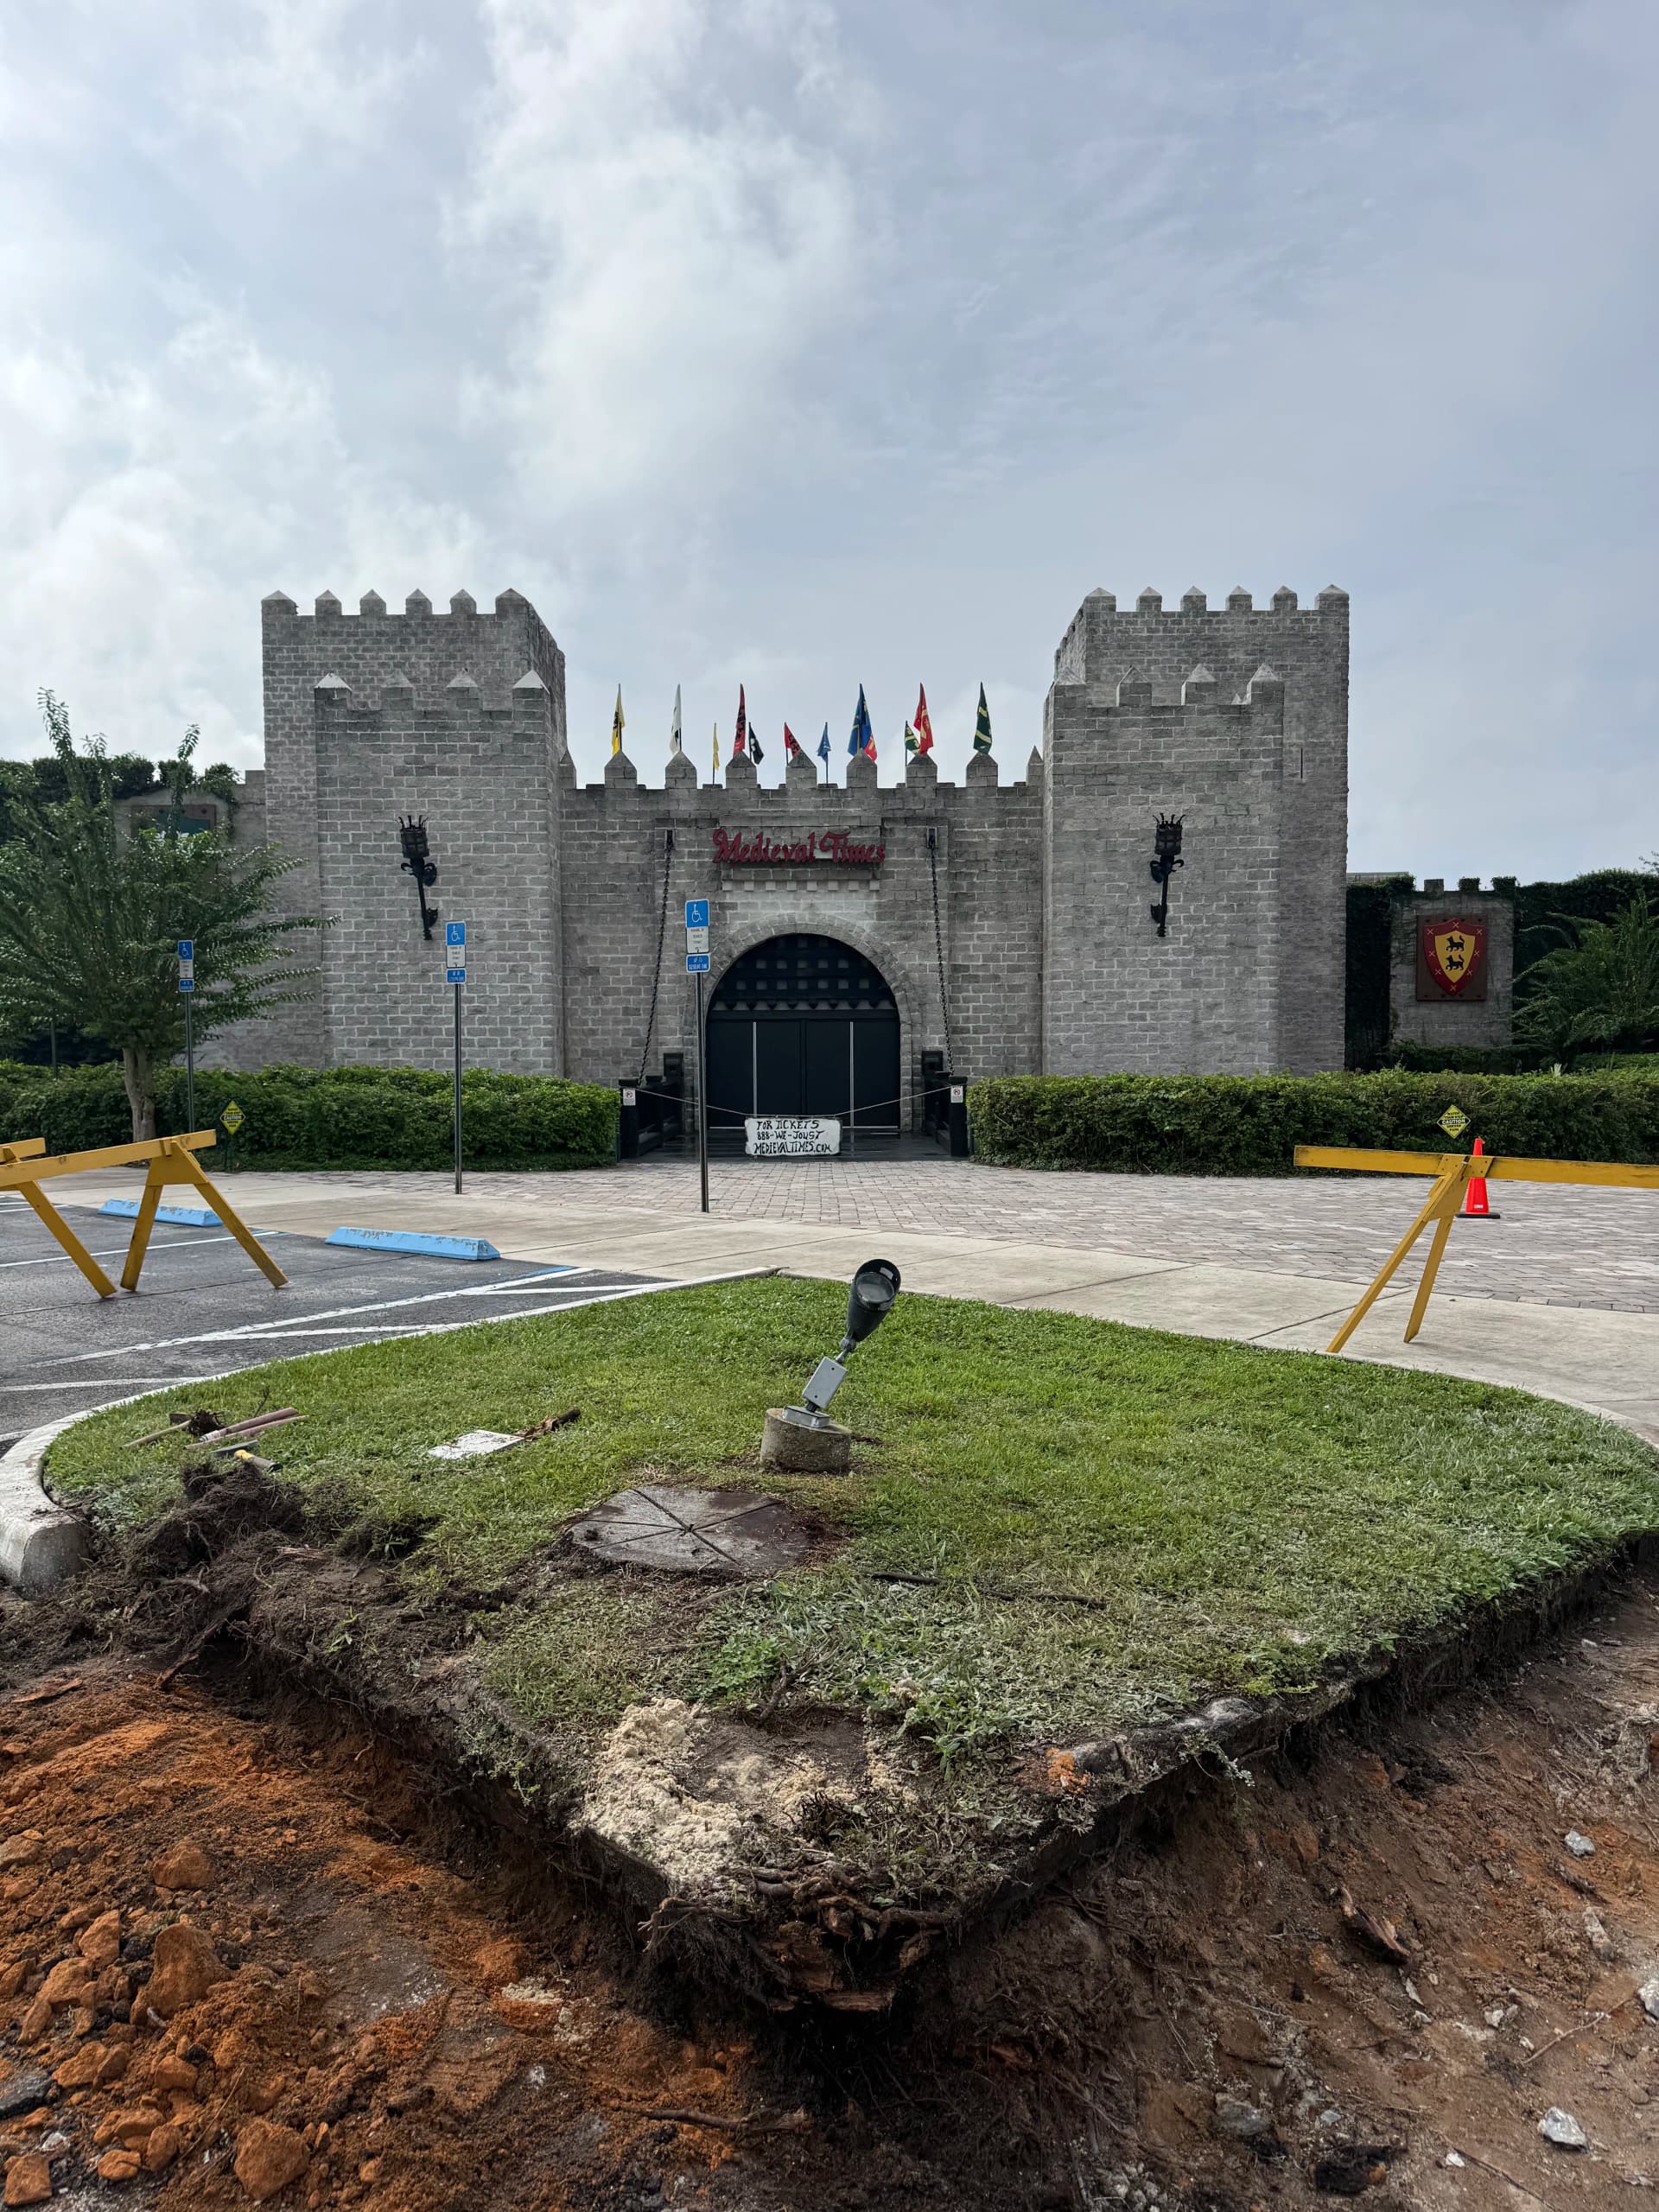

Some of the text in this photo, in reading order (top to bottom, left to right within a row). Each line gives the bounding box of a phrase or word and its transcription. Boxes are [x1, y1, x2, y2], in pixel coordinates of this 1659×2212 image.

[712, 829, 886, 863] Medieval Times
[756, 1120, 820, 1130] FOR TICKETS
[756, 1130, 824, 1140] 888-WE-JOUST
[753, 1141, 832, 1154] MEDIEVALTIMES.COM
